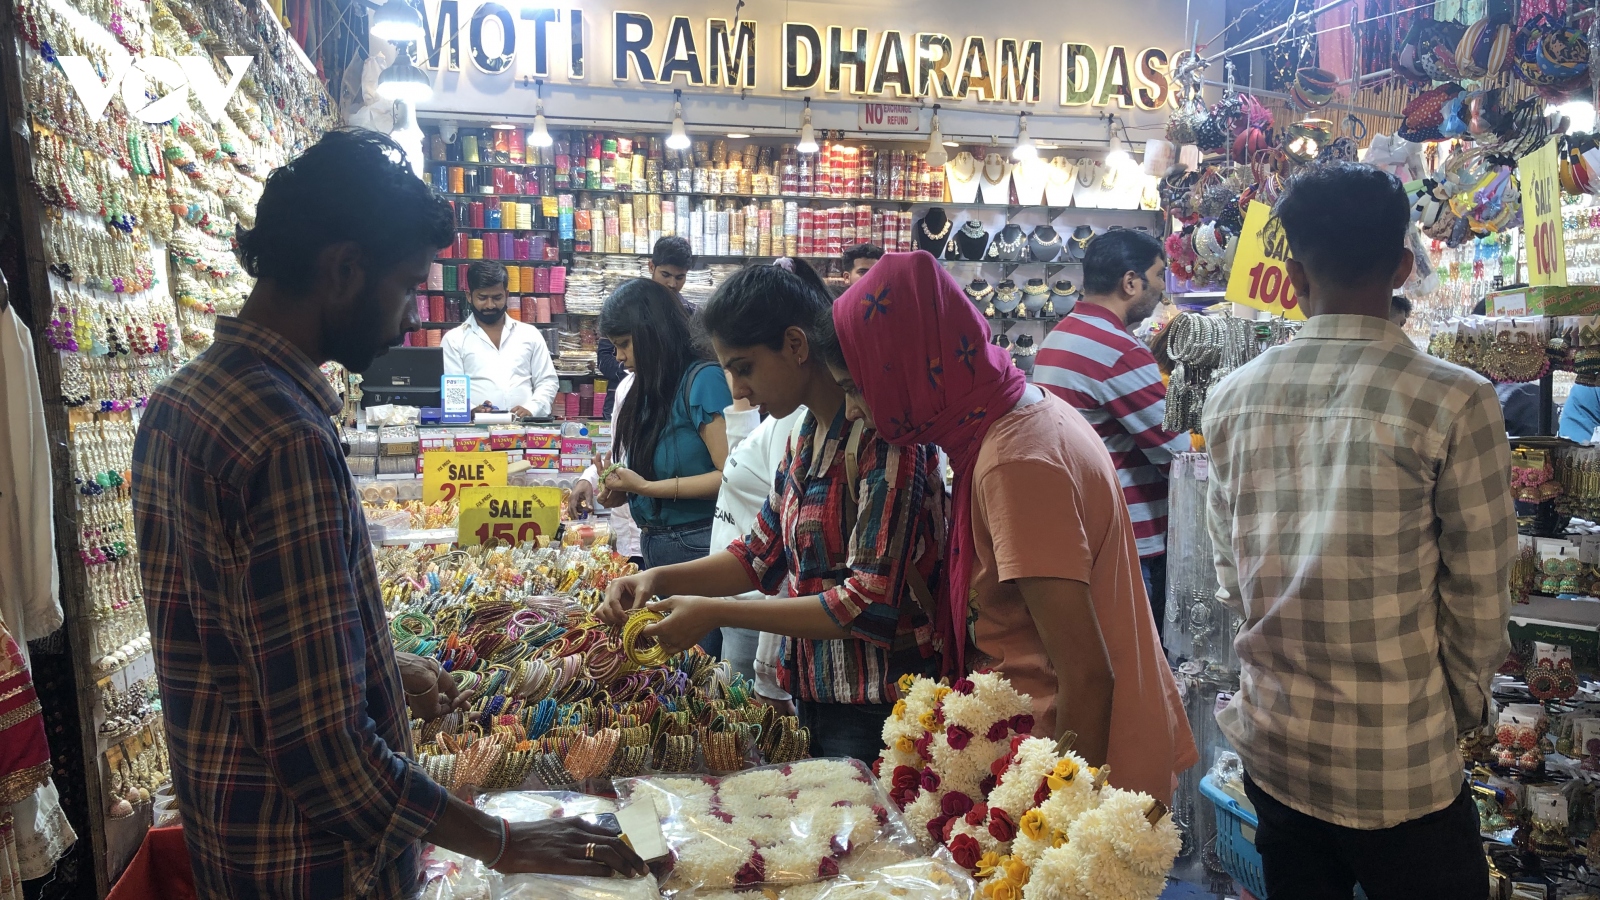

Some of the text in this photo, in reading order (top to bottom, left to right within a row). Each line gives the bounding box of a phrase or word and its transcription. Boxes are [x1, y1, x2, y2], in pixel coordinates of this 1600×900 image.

[414, 0, 585, 79] MOTI
[612, 10, 757, 88] RAM
[781, 22, 1043, 103] DHARAM
[866, 103, 912, 124] NO EXCHANGE
[887, 115, 909, 125] REFUND
[1534, 177, 1551, 217] SALE
[1533, 219, 1557, 275] 100
[448, 464, 484, 481] SALE
[489, 499, 532, 518] SALE
[475, 521, 542, 550] 150
